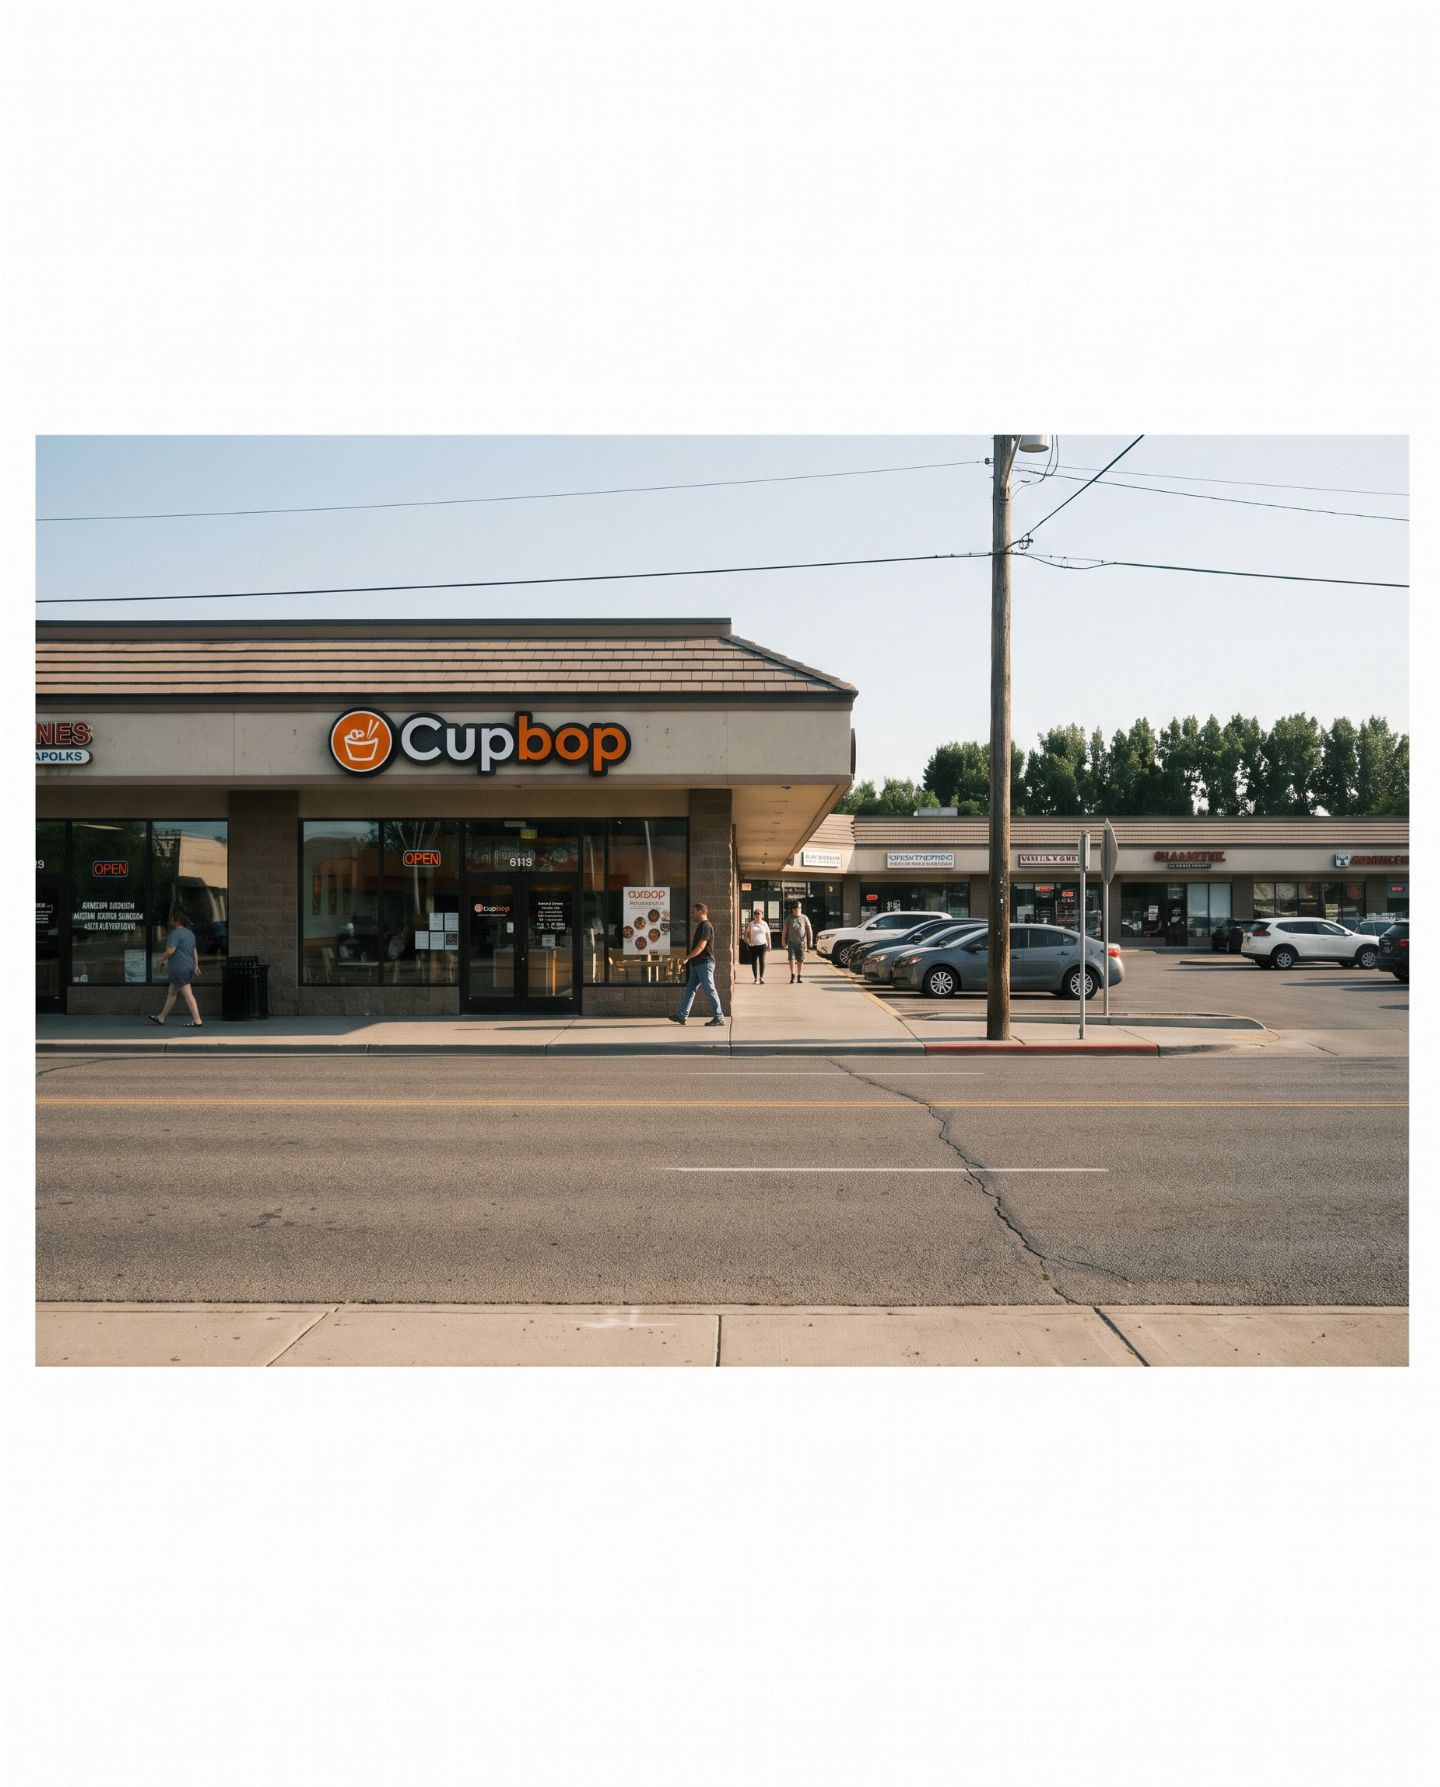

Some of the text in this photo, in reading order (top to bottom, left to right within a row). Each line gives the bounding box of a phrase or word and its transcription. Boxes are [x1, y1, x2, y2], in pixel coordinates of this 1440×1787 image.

[36, 721, 92, 746] NES
[401, 715, 627, 772] Cupbop
[404, 853, 439, 865] OPEN
[94, 863, 127, 875] OPEN
